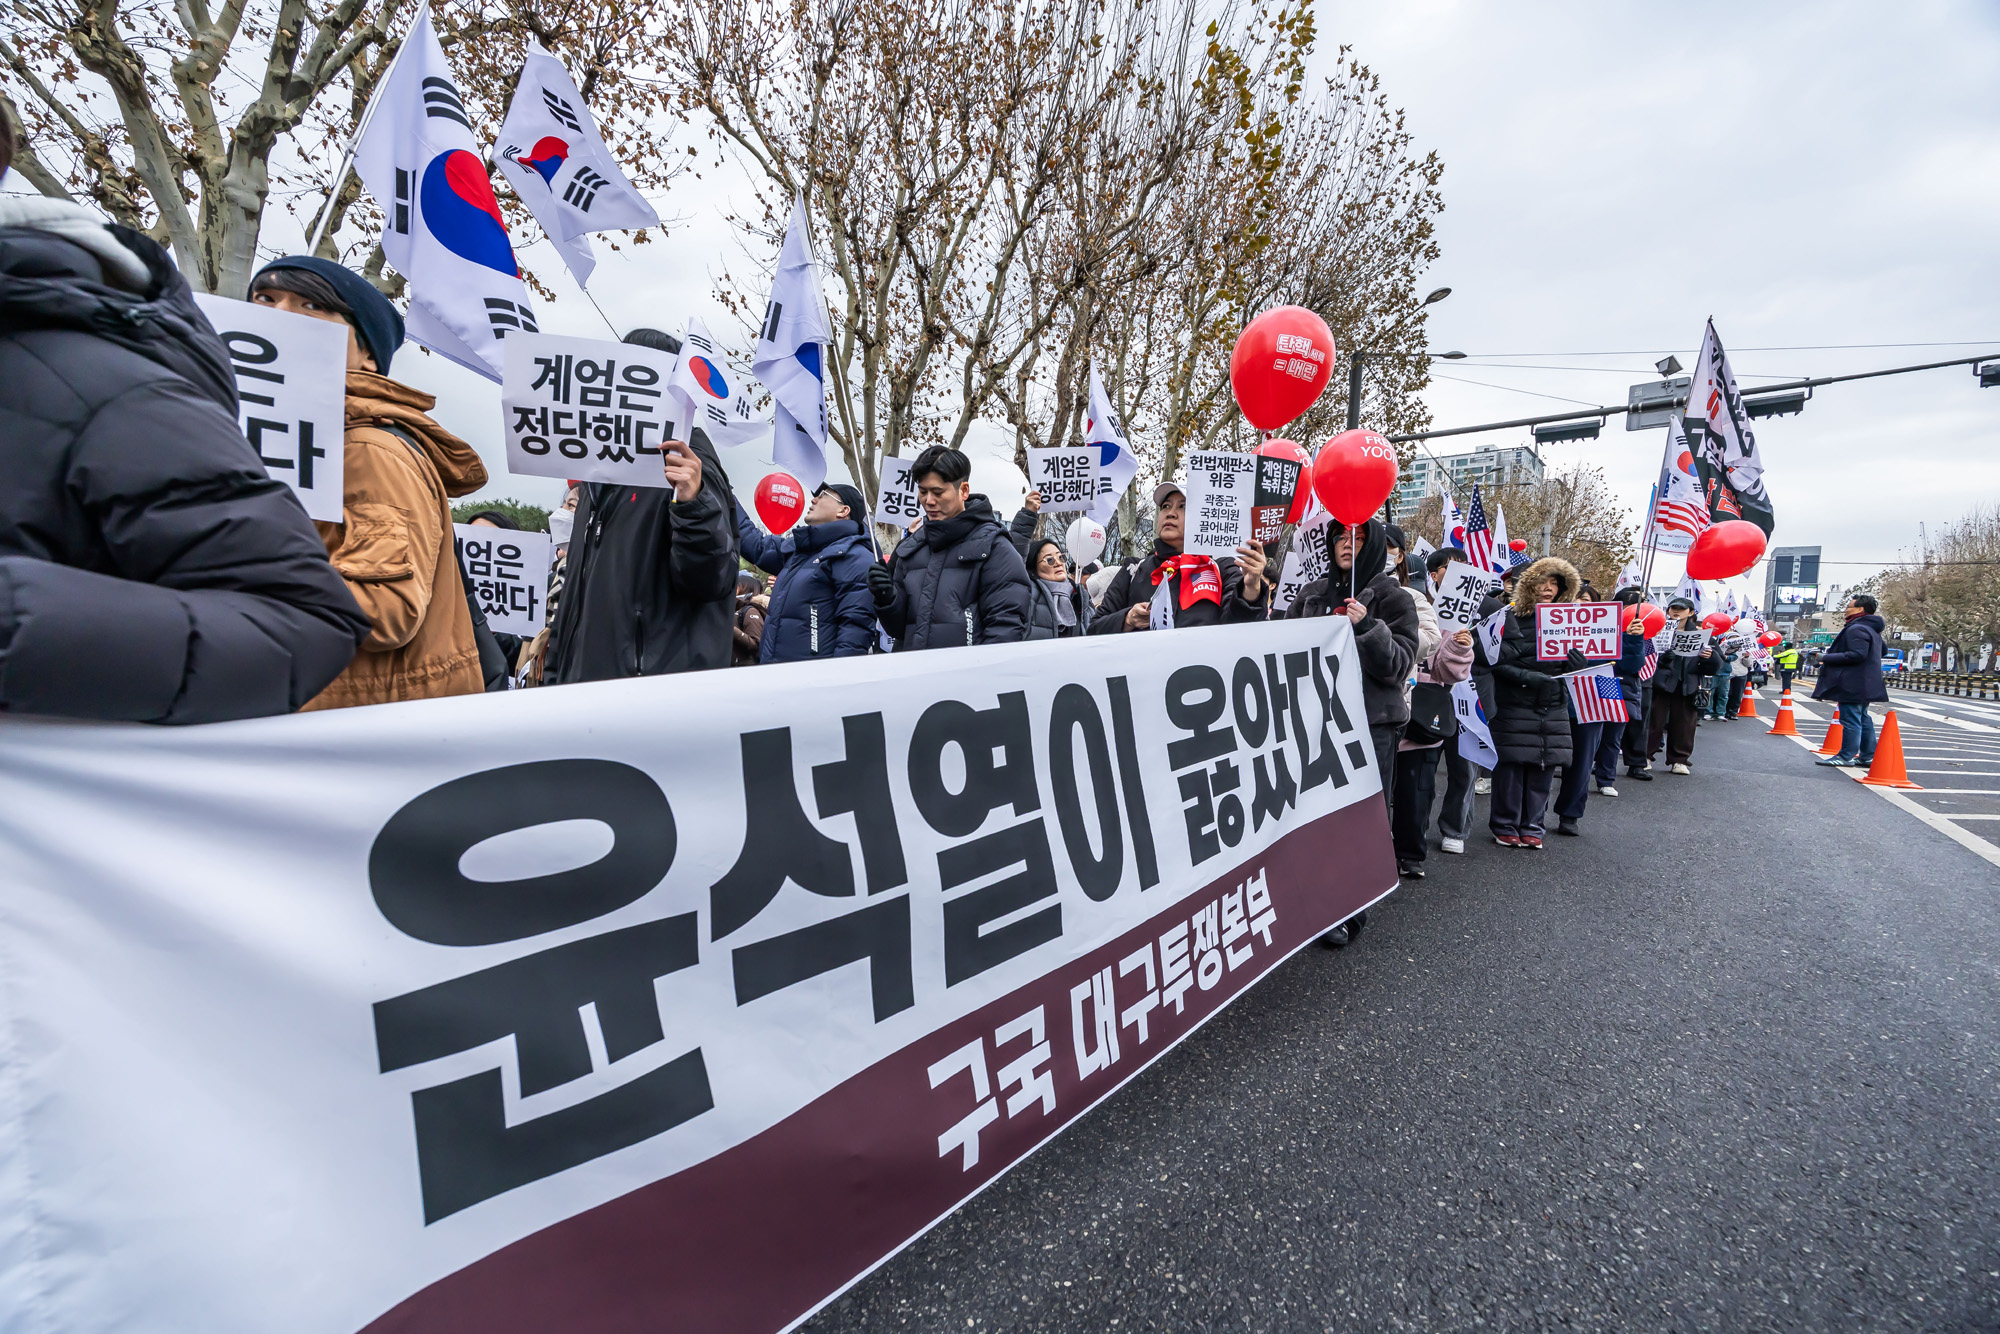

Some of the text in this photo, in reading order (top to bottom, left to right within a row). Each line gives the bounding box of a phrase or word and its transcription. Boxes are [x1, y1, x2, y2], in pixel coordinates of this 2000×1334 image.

[1276, 333, 1313, 359] 탄핵
[1286, 358, 1319, 383] 내란
[531, 354, 661, 413] 계엄은
[512, 406, 679, 466] 정당했다
[1042, 455, 1090, 479] 계엄은
[1189, 454, 1254, 473] 헌법재판소
[1261, 460, 1299, 481] 계엄 당시
[895, 469, 915, 493] 계
[1036, 479, 1096, 504] 정당했다
[1209, 472, 1236, 489] 위증
[1261, 476, 1296, 497] 녹취 공개
[882, 491, 920, 518] 정당
[1204, 494, 1238, 508] 곽종근:
[1200, 507, 1240, 522] 국회의원
[1259, 507, 1285, 526] 곽종근
[1199, 520, 1239, 535] 끌어내라
[1300, 522, 1331, 554] 계엄
[1193, 534, 1242, 547] 지시받았다
[458, 537, 524, 580] 엄은
[473, 578, 538, 622] 했다
[1438, 595, 1478, 624] 정당
[1549, 607, 1608, 625] STOP
[966, 632, 974, 646] SPO
[1565, 626, 1591, 637] THE
[1676, 633, 1702, 644] 엄은
[1544, 638, 1613, 656] STEAL
[368, 646, 1368, 1228] 윤석열이 옳았다!
[927, 866, 1278, 1173] 구국 대구투쟁본부
